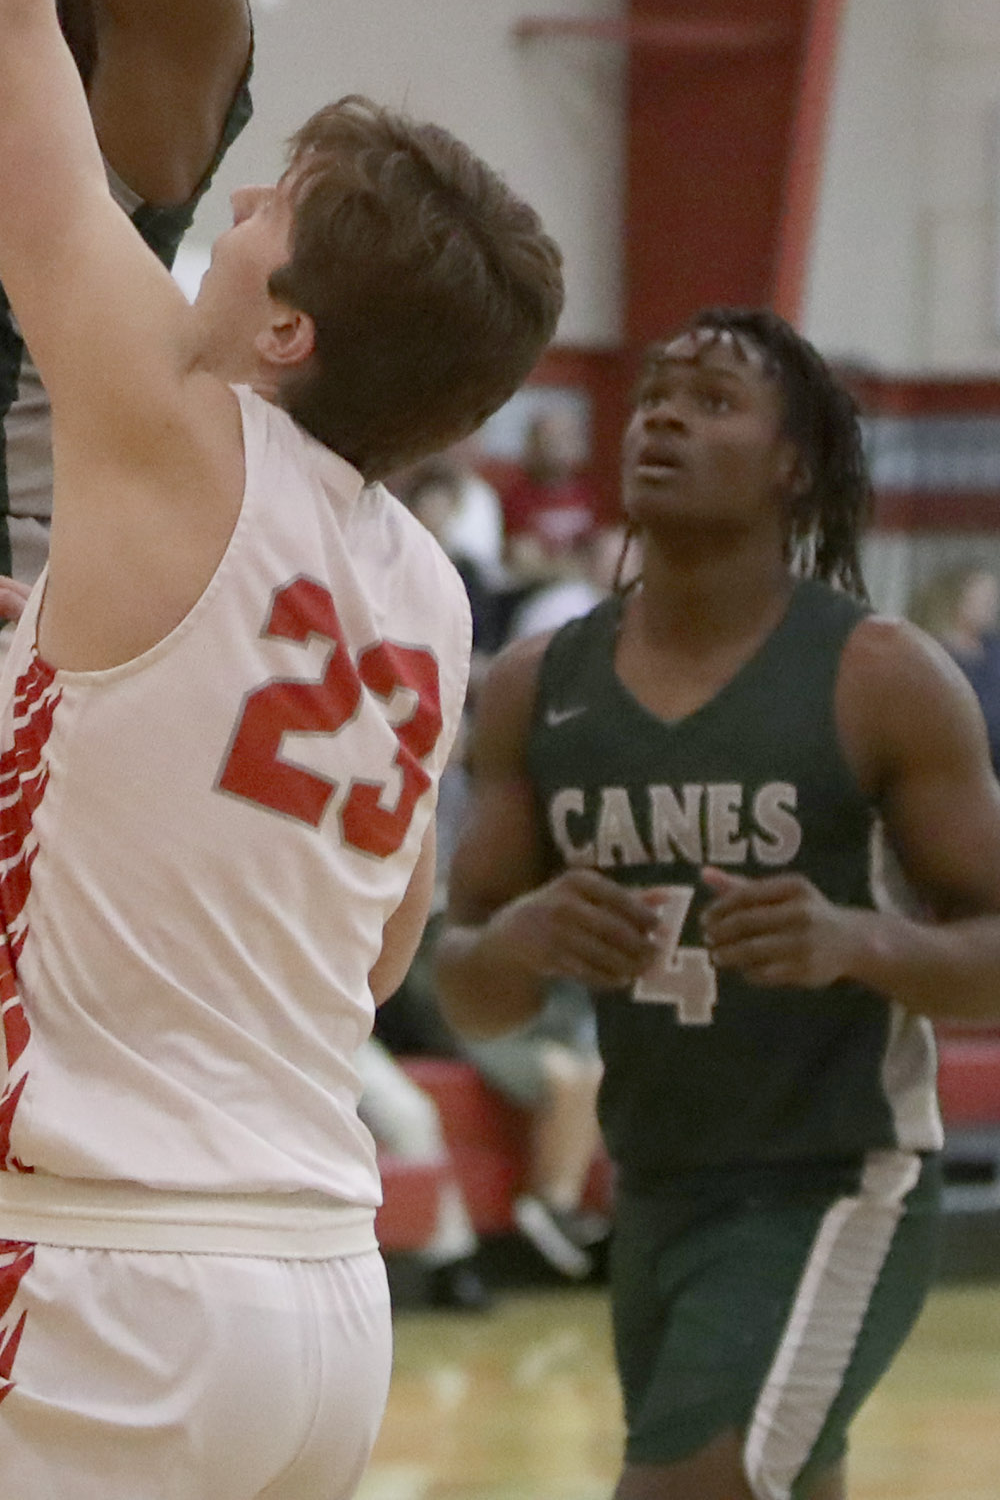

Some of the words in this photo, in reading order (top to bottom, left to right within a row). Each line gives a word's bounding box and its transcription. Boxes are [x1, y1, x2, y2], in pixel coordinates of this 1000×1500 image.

[212, 572, 443, 863] 23
[550, 781, 802, 868] CANES
[632, 885, 717, 1025] 4
